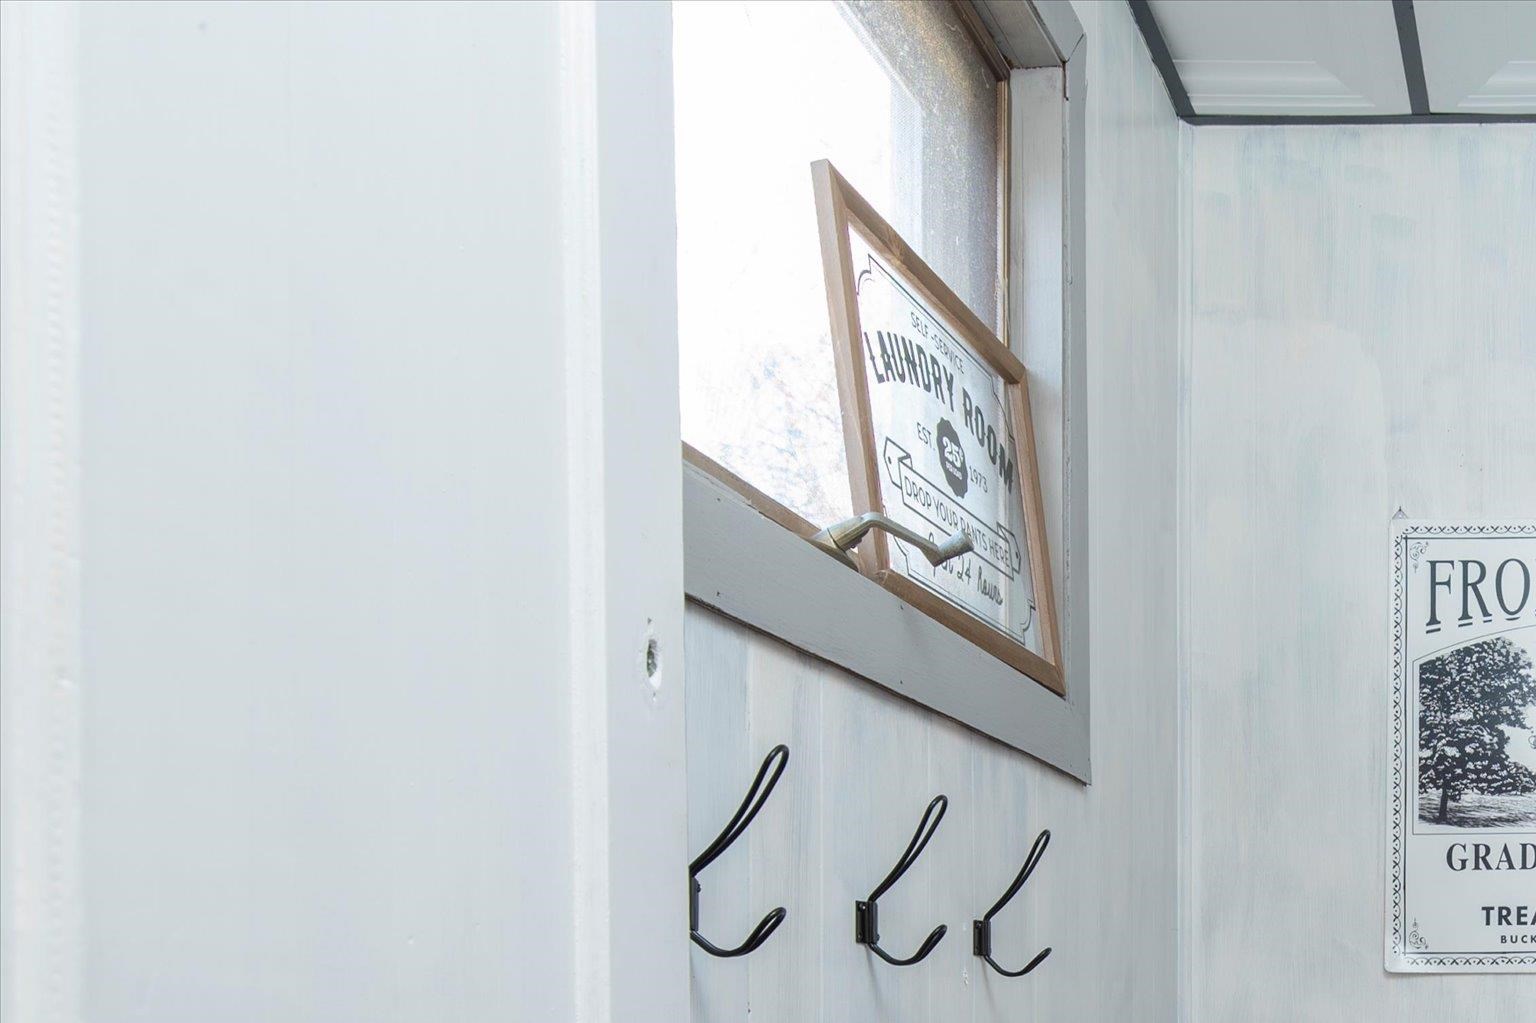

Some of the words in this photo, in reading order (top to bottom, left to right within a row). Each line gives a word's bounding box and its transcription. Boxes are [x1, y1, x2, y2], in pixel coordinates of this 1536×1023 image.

[864, 330, 955, 412] LAUNDRY
[962, 387, 1014, 494] ROOM
[916, 421, 936, 451] EST.
[969, 466, 988, 494] 1973
[904, 475, 932, 511] DROP
[935, 499, 958, 530] YOUR
[960, 516, 988, 551] PANTS
[989, 534, 1010, 569] HERE
